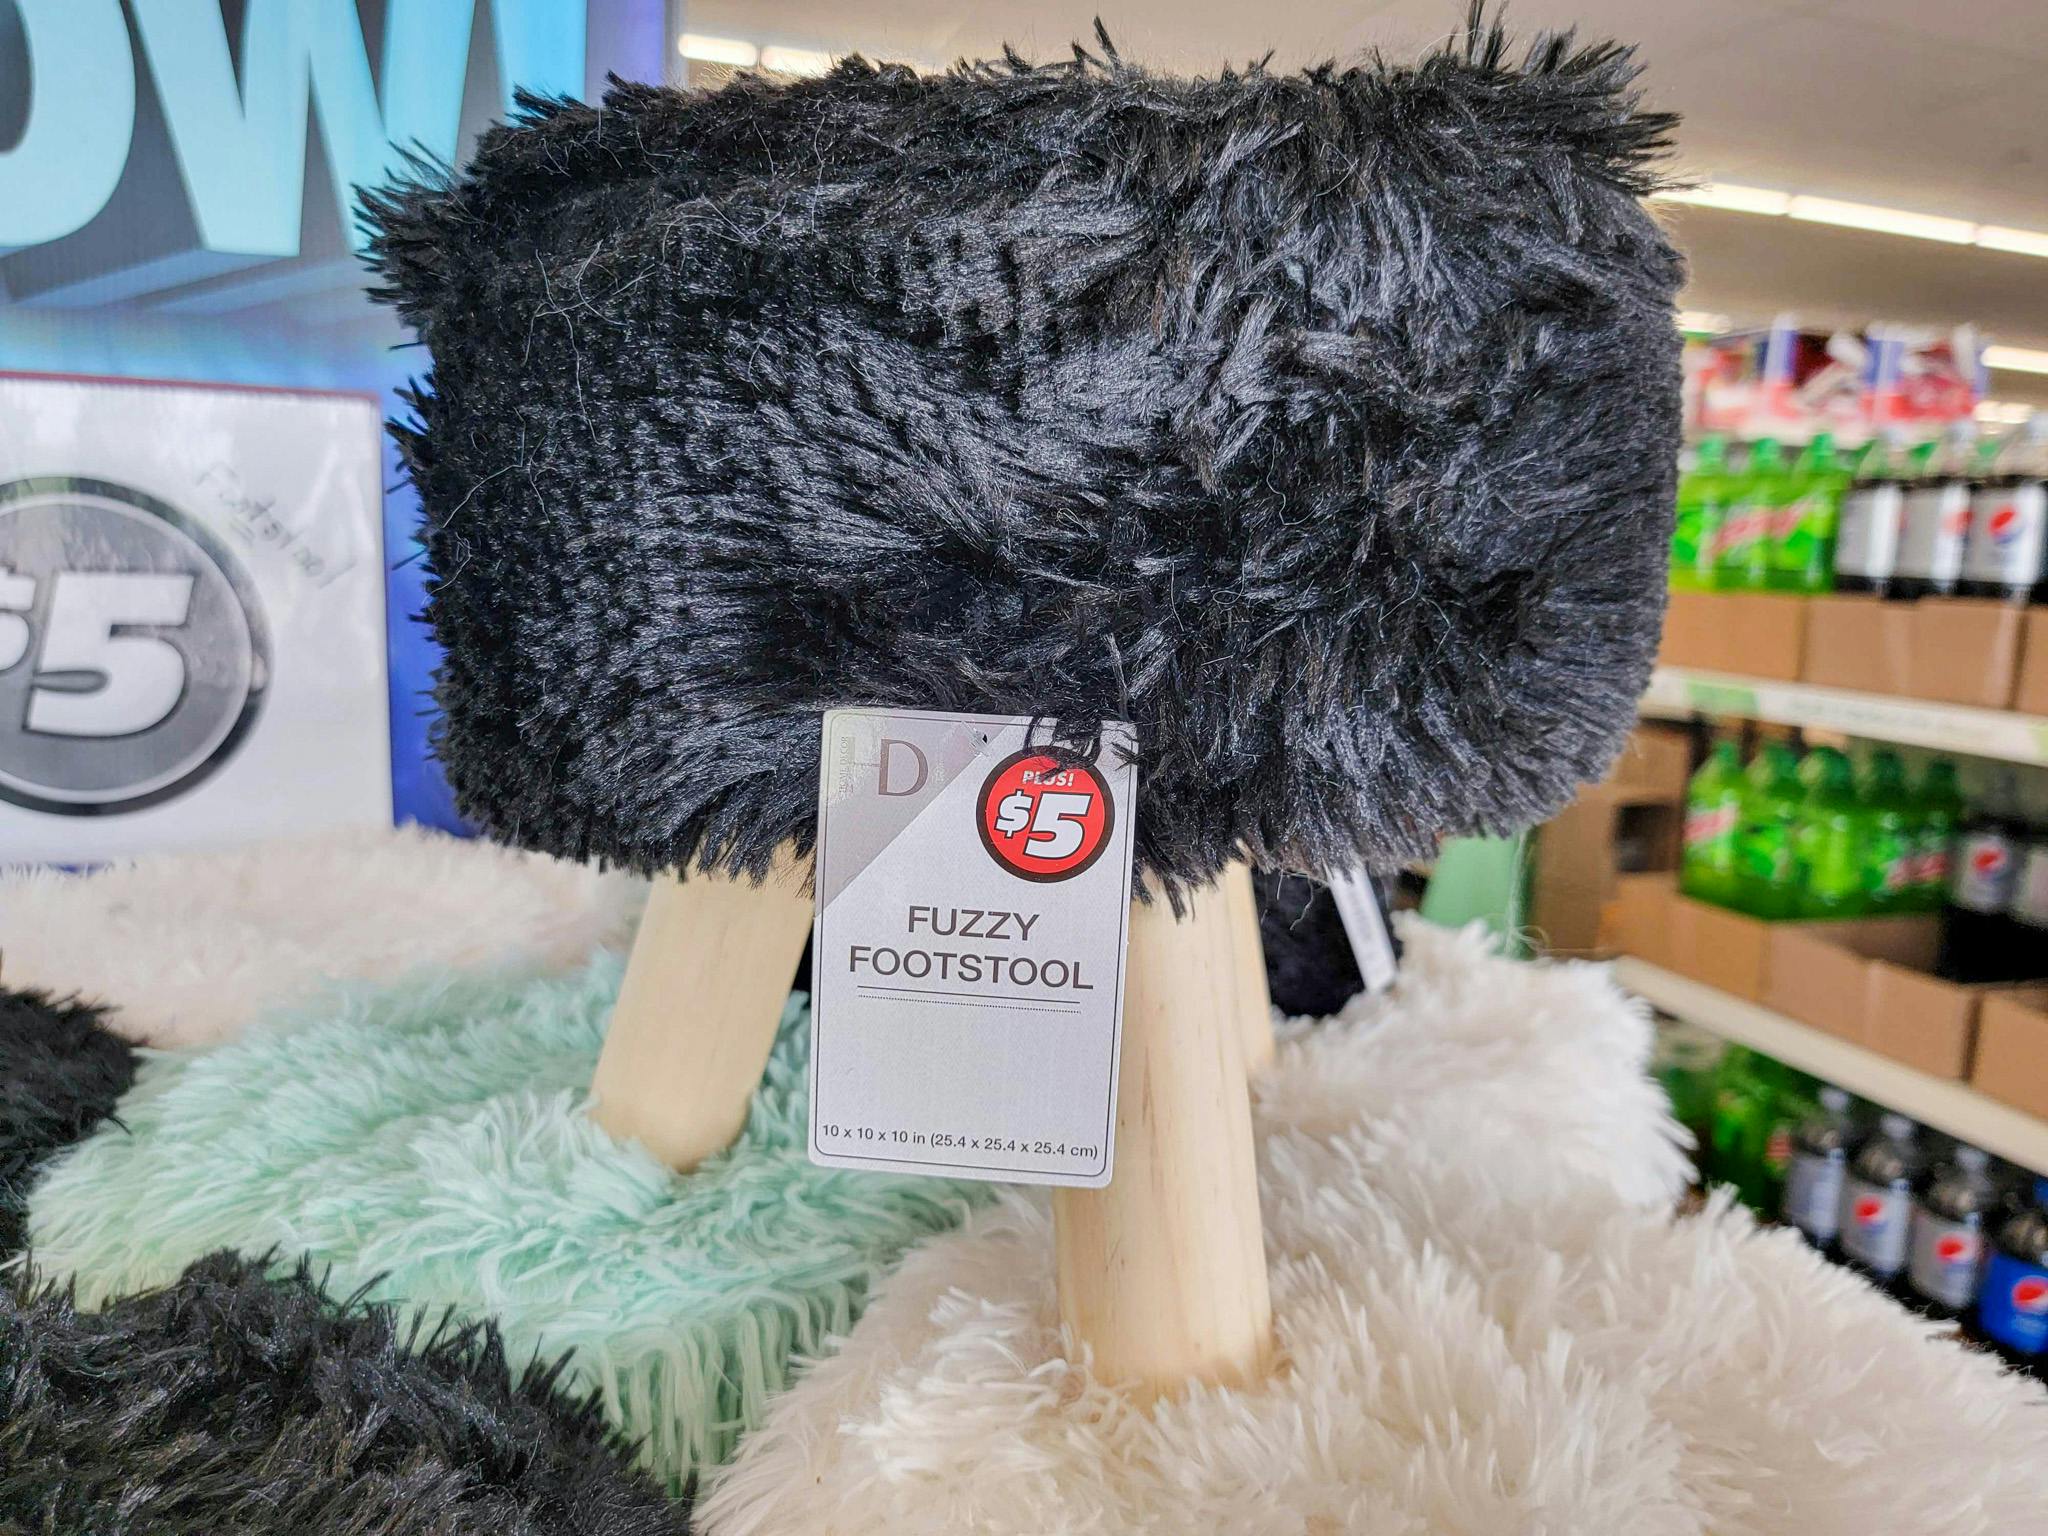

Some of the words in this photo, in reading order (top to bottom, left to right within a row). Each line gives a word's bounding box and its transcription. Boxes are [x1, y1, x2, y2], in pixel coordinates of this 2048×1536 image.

[839, 736, 849, 765] DECOR
[878, 738, 929, 796] D
[838, 768, 849, 793] HOME
[994, 788, 1094, 860] $5
[908, 905, 1040, 941] FUZZY
[849, 945, 1094, 990] FOOTSTOOL
[823, 1124, 839, 1137] 10
[843, 1128, 852, 1138] x
[857, 1127, 874, 1140] 10
[878, 1131, 887, 1141] x
[891, 1130, 908, 1143] 10
[912, 1131, 926, 1144] in
[930, 1132, 967, 1148] (25.4
[971, 1139, 980, 1149] x
[984, 1137, 1016, 1152] 25.4
[1020, 1143, 1029, 1153] x
[1034, 1141, 1065, 1155] 25.4
[1070, 1145, 1098, 1160] cm)
